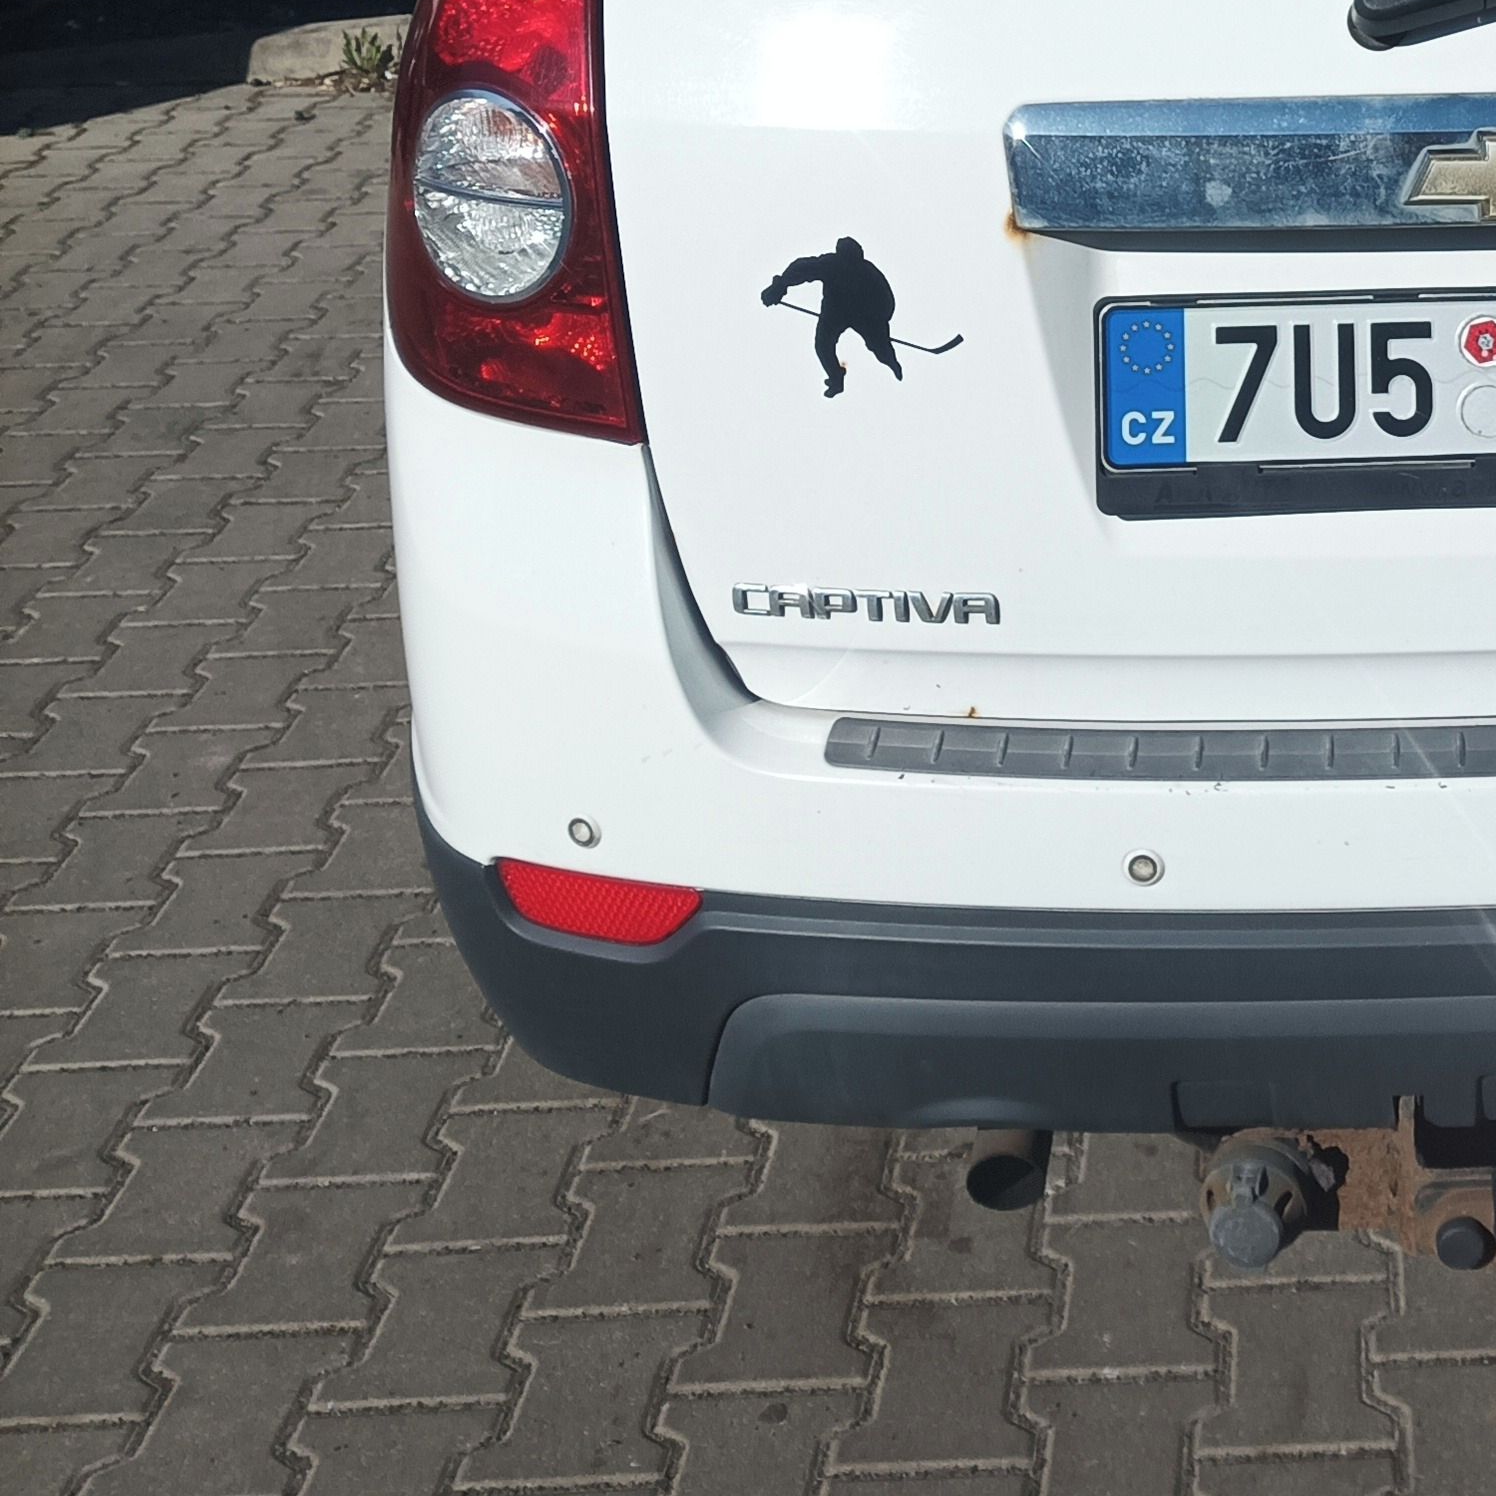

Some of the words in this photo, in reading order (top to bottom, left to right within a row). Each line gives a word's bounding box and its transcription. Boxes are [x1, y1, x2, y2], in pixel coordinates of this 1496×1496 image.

[1213, 322, 1434, 444] 7U5
[1120, 409, 1176, 447] CZ
[731, 582, 1001, 625] CAPTIVA
